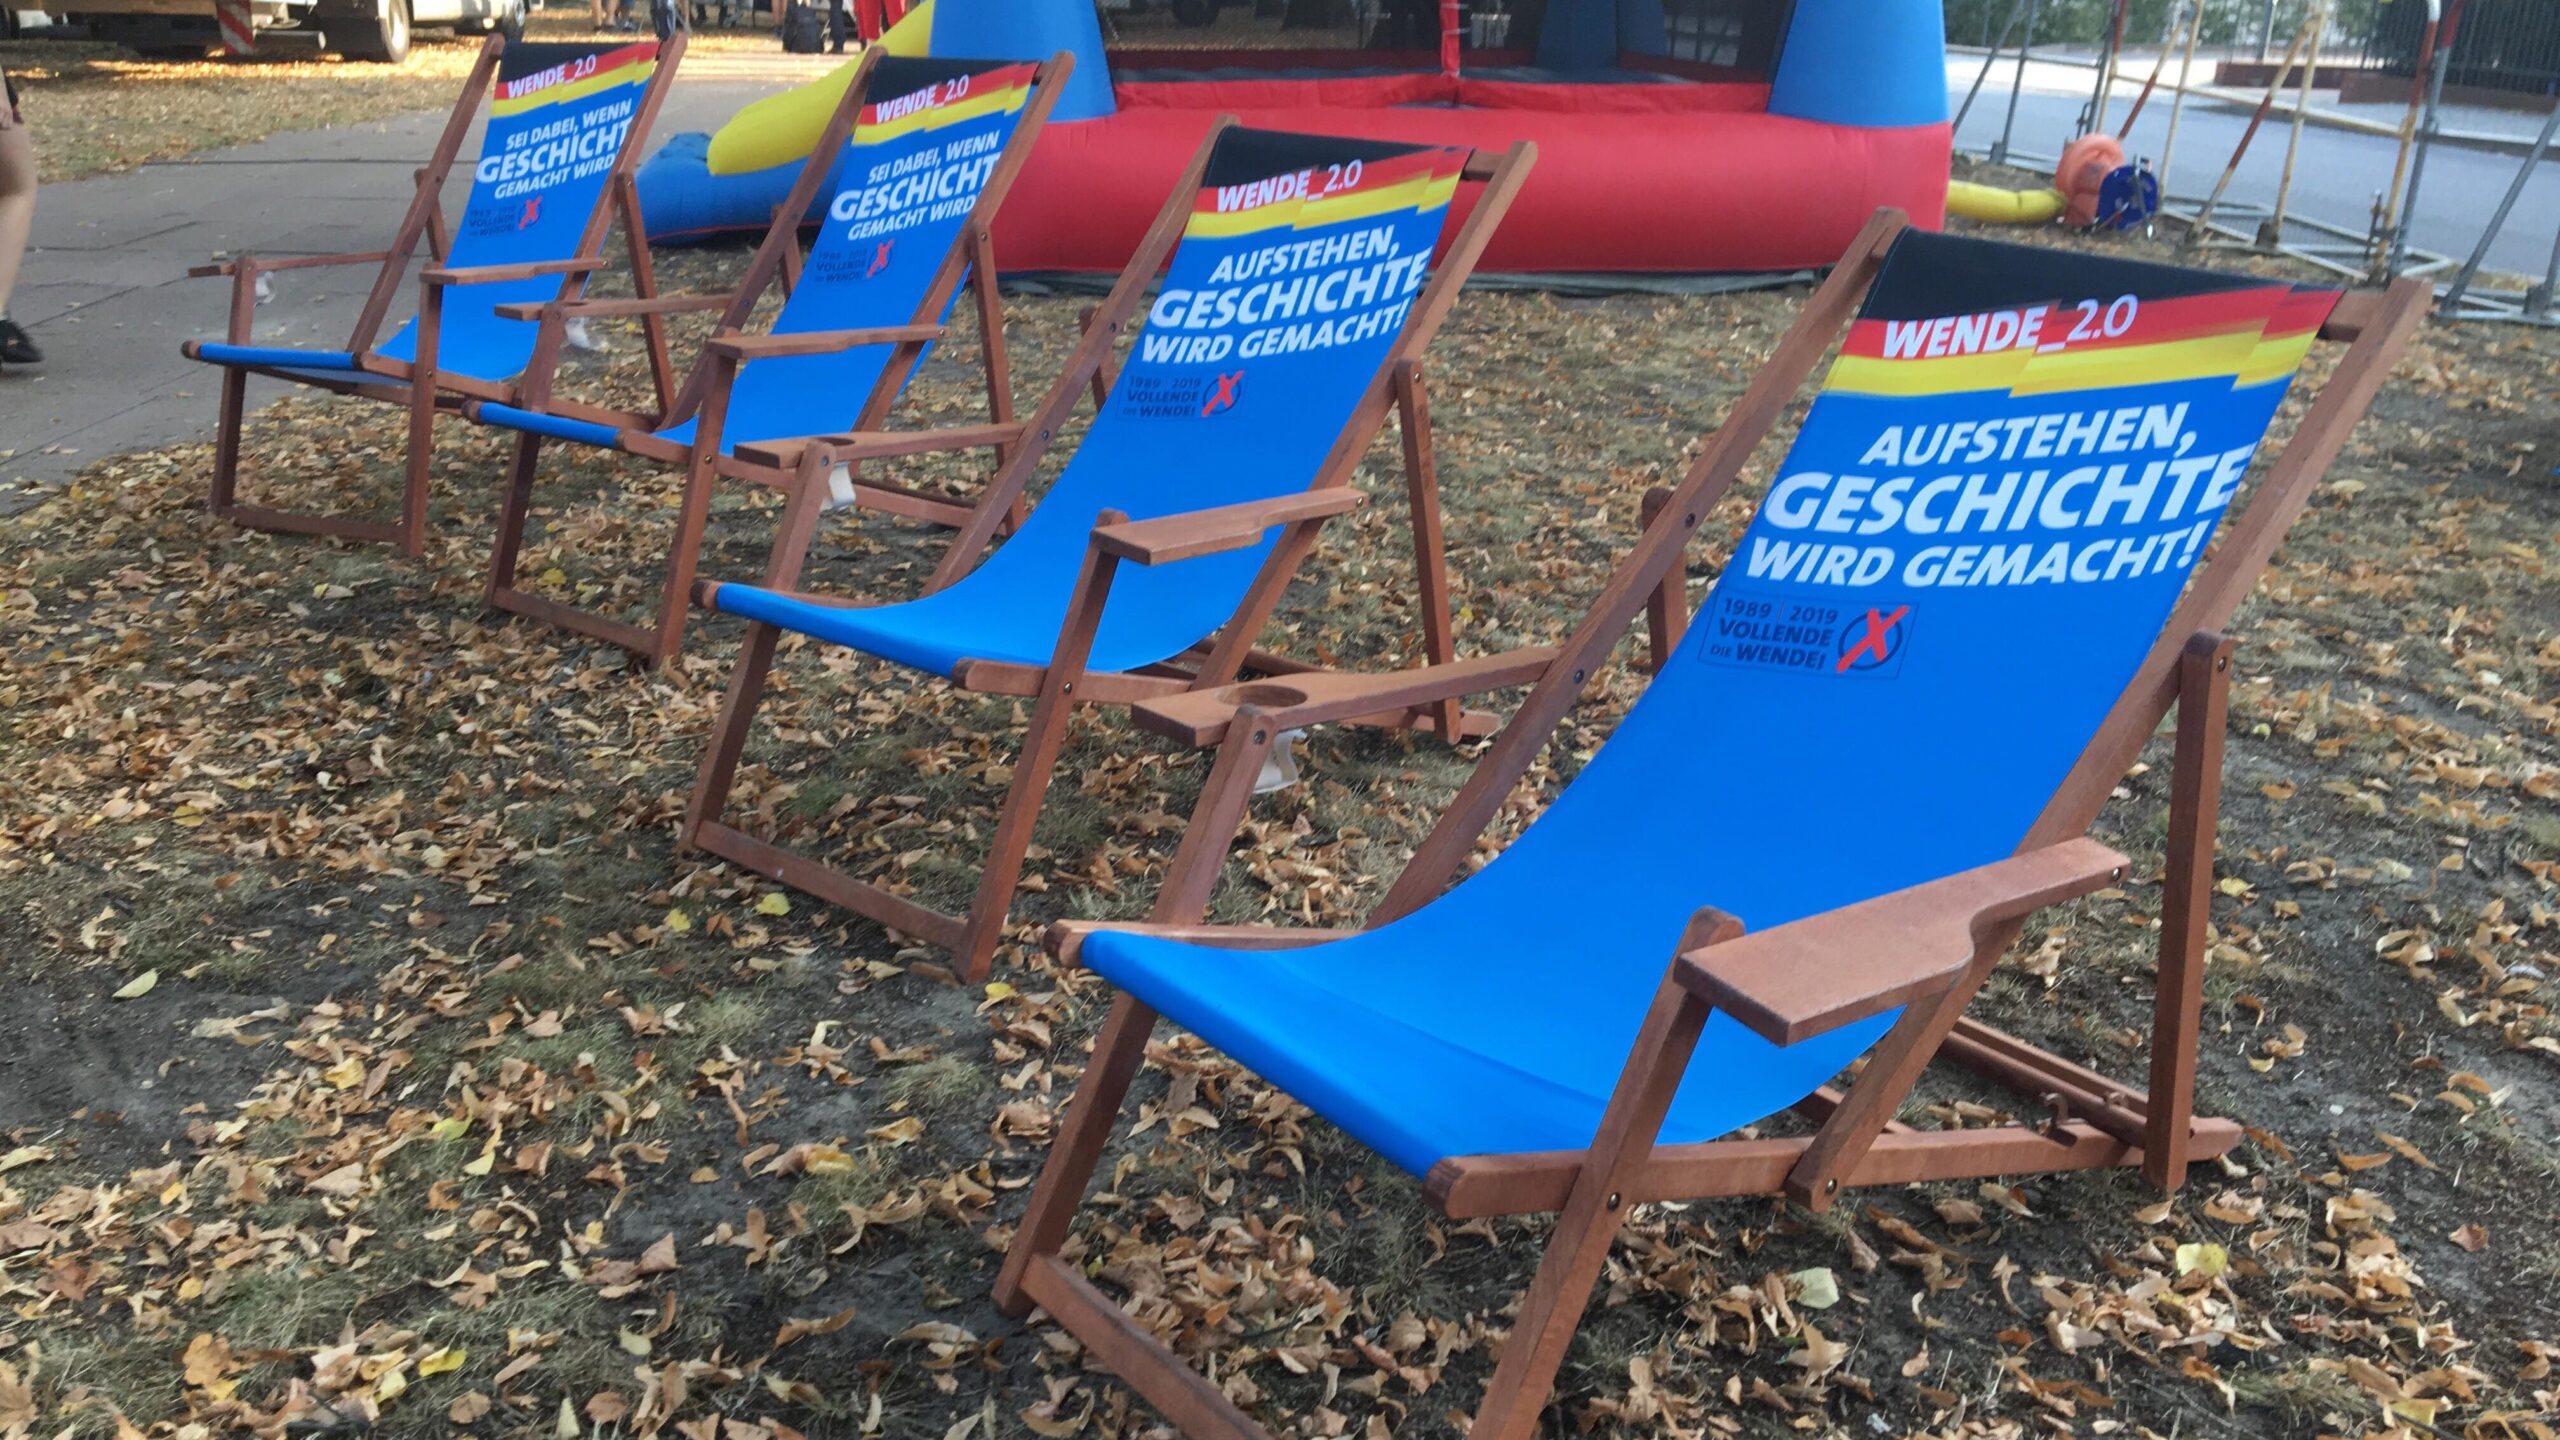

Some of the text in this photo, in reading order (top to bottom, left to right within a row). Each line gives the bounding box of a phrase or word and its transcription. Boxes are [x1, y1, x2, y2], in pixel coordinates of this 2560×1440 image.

[507, 54, 597, 99] WENDE_2.0
[875, 74, 970, 125] WENDE_2.0
[475, 115, 633, 184] GESCHICHT
[507, 98, 632, 152] SEI DABEI, WENN
[494, 166, 571, 200] GEMACHT
[867, 130, 1000, 185] SEI DABEI, WENN
[830, 152, 1002, 222] GESCHICHT
[1216, 159, 1363, 213] WENDE_2.0
[848, 206, 927, 241] GEMACHT
[1207, 224, 1400, 284] AUFSTEHEN,
[1149, 245, 1434, 330] GESCHICHTE
[1141, 296, 1412, 364] WIRD GEMACHT!
[1883, 293, 2139, 361] WENDE_2.0
[1127, 390, 1199, 402] VOLLENDE
[1140, 404, 1196, 417] WENDE!
[1857, 400, 2198, 468] AUFSTEHEN,
[1763, 440, 2258, 535] GESCHICHTE
[1746, 518, 2212, 589] WIRD GEMACHT!
[1718, 618, 1834, 647] VOLLENDE
[1724, 597, 1838, 625] 1989 2019
[1710, 643, 1827, 671] DIE WENDE!
